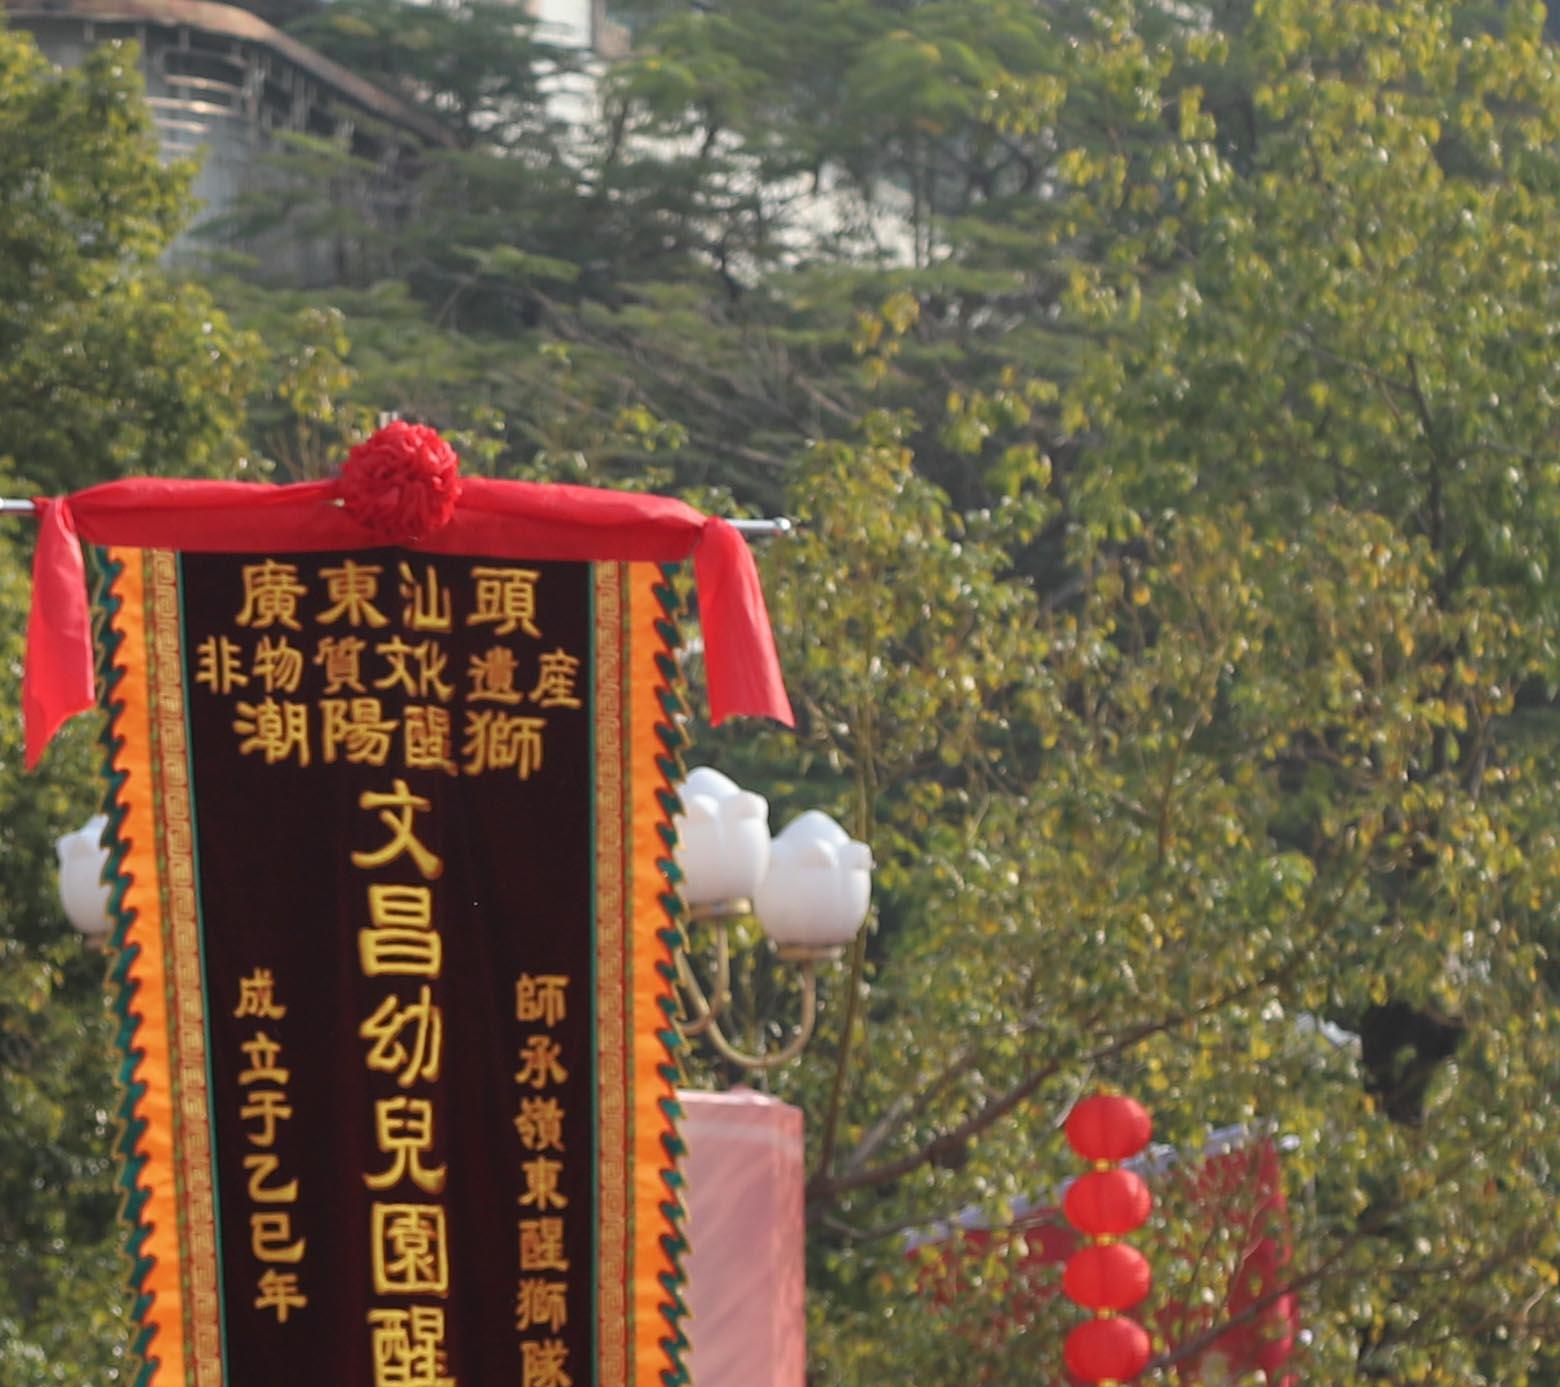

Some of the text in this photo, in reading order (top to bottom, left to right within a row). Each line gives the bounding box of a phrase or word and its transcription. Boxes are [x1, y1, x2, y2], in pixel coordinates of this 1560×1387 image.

[234, 558, 543, 640] 廣東汕頭
[232, 697, 548, 781] 潮陽醒獅
